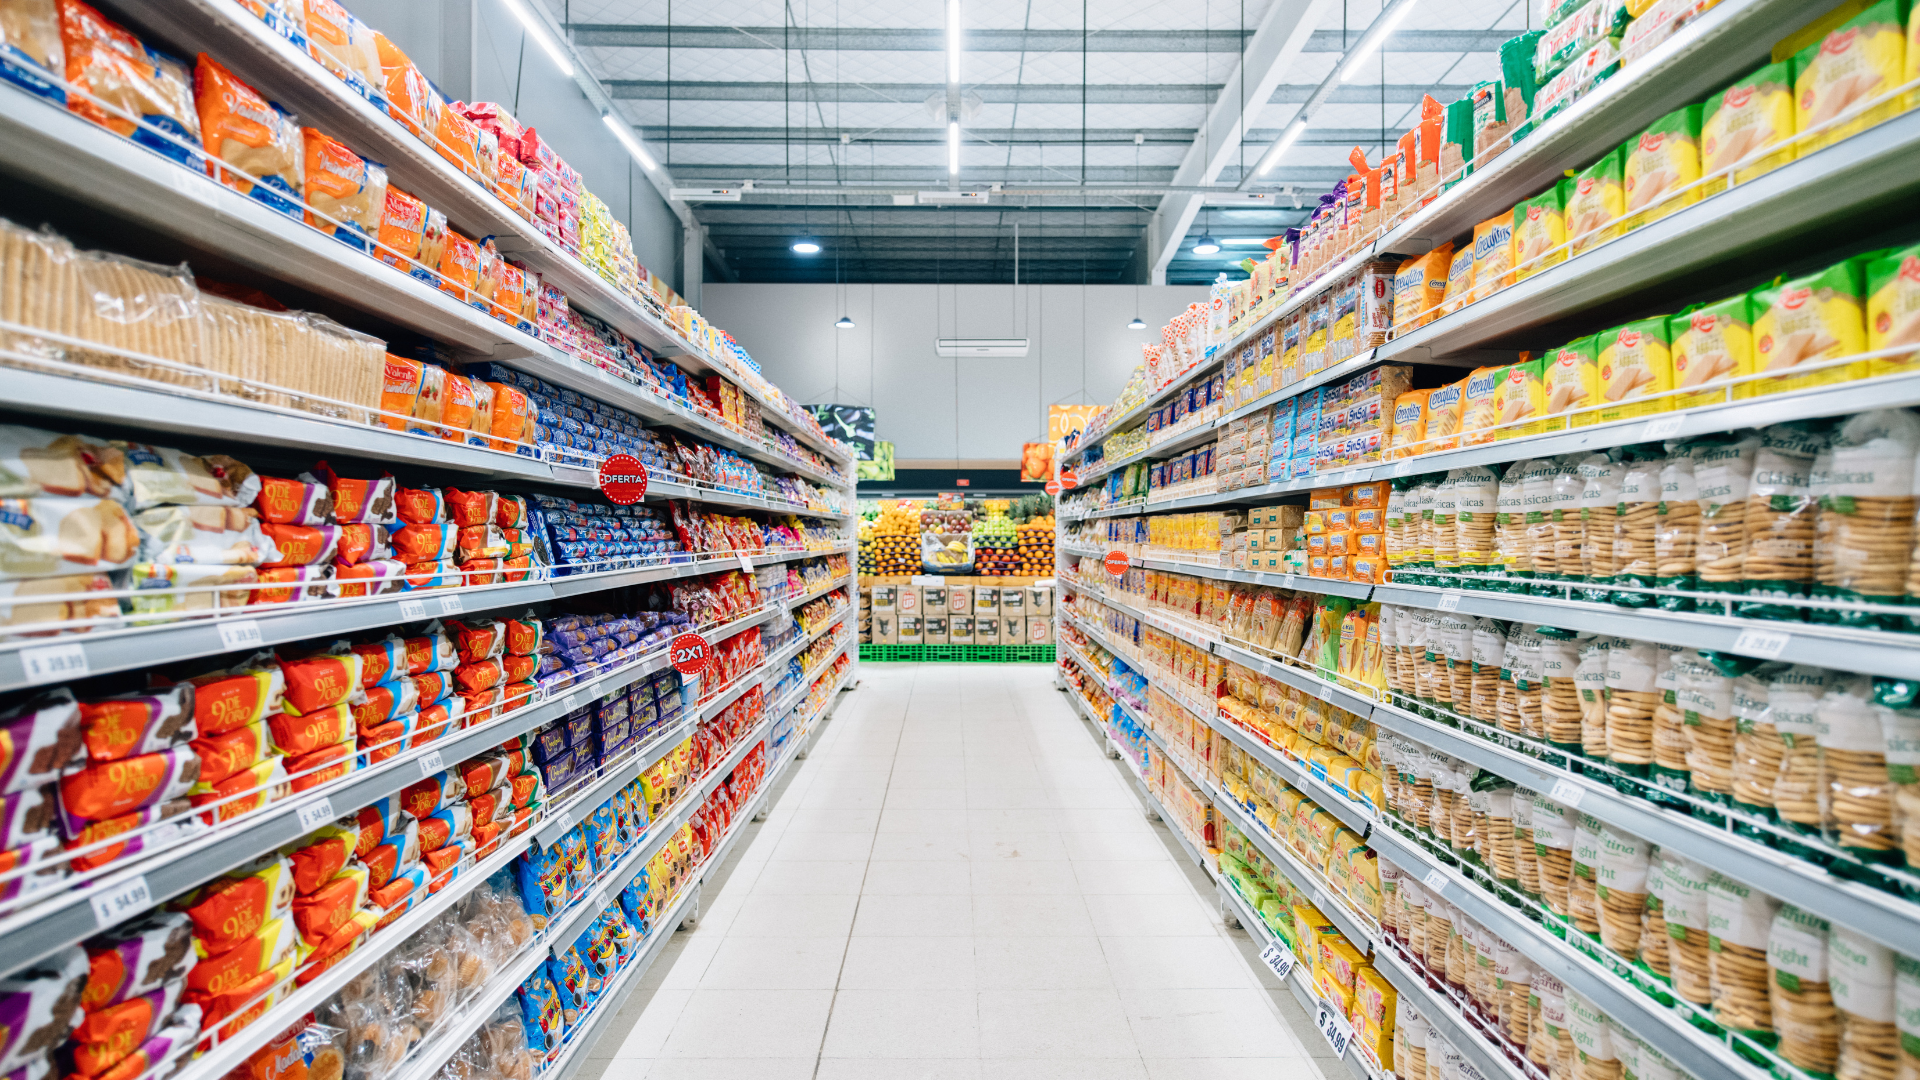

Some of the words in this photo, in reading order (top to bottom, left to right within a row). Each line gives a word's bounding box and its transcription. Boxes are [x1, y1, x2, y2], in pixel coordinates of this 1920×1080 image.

[1474, 224, 1511, 260] Cerealitas
[1691, 311, 1718, 333] Riera
[1617, 327, 1642, 348] Riera
[1557, 348, 1578, 367] Riera
[386, 365, 416, 381] Valente
[1508, 367, 1525, 385] Riera
[1349, 374, 1368, 392] SinSal
[1429, 386, 1461, 410] Cerealitas
[1348, 406, 1367, 422] SinSal
[1395, 403, 1421, 425] Cerealitas
[1319, 416, 1336, 431] SinSal
[1316, 445, 1335, 459] SinSal
[1345, 438, 1367, 454] SinSal
[604, 474, 643, 484] OFERTA
[265, 484, 277, 504] 9
[342, 490, 352, 500] DE
[342, 502, 358, 512] ORO
[417, 533, 425, 551] 9
[425, 533, 433, 543] DE
[425, 543, 438, 553] ORO
[281, 542, 292, 562] 9
[903, 599, 915, 608] UP
[953, 600, 965, 609] UP
[515, 633, 523, 649] 9
[523, 633, 532, 642] DE
[1034, 630, 1045, 640] UP
[522, 641, 534, 651] ORO
[676, 644, 704, 663] 2X1
[315, 677, 325, 700] 9
[324, 675, 337, 688] DE
[477, 671, 484, 687] 9
[324, 685, 344, 701] ORO
[212, 701, 226, 728] 9
[226, 695, 241, 710] DE
[224, 706, 251, 725] ORO
[305, 724, 318, 748] 9
[318, 721, 331, 735] DE
[109, 763, 127, 796] 9
[304, 814, 310, 825] $
[312, 804, 332, 820] 54.99
[101, 903, 110, 918] $
[223, 917, 239, 939] 9
[1263, 947, 1274, 959] $
[1269, 954, 1290, 977] 34.99
[1770, 941, 1809, 967] Light
[1319, 1011, 1327, 1027] $
[1326, 1020, 1346, 1054] 34.99
[1569, 1023, 1594, 1048] Light
